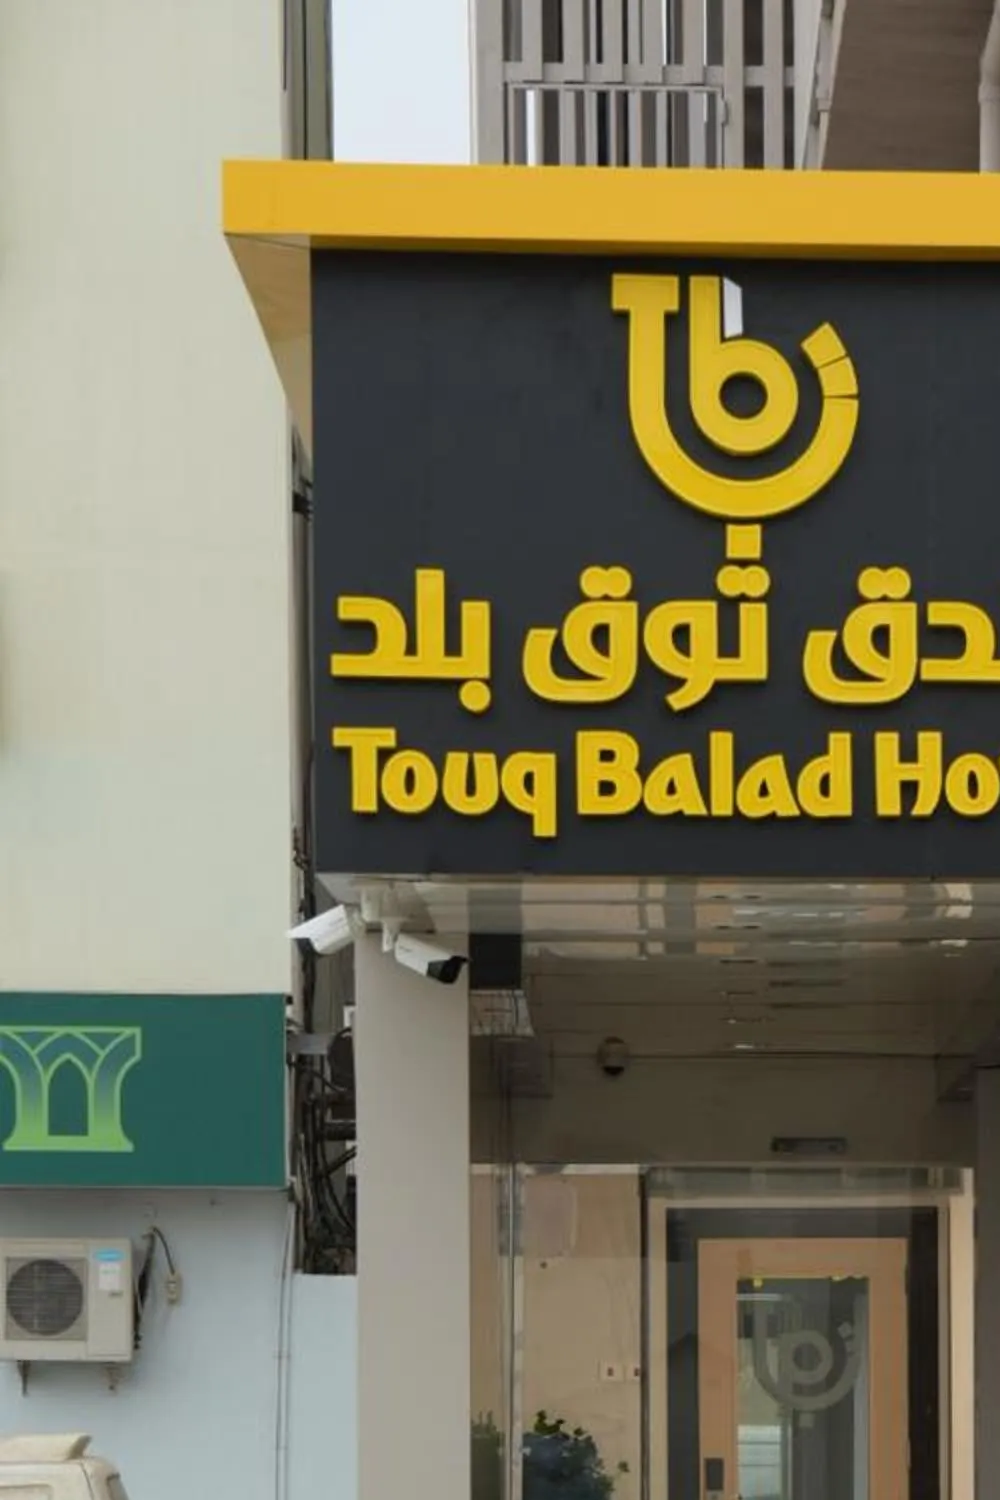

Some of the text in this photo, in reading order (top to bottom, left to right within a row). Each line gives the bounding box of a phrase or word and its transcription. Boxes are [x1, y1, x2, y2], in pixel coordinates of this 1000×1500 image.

[329, 567, 492, 713] بلد
[521, 563, 772, 712] توق
[330, 725, 558, 838] Touq
[575, 728, 854, 819] Balad
